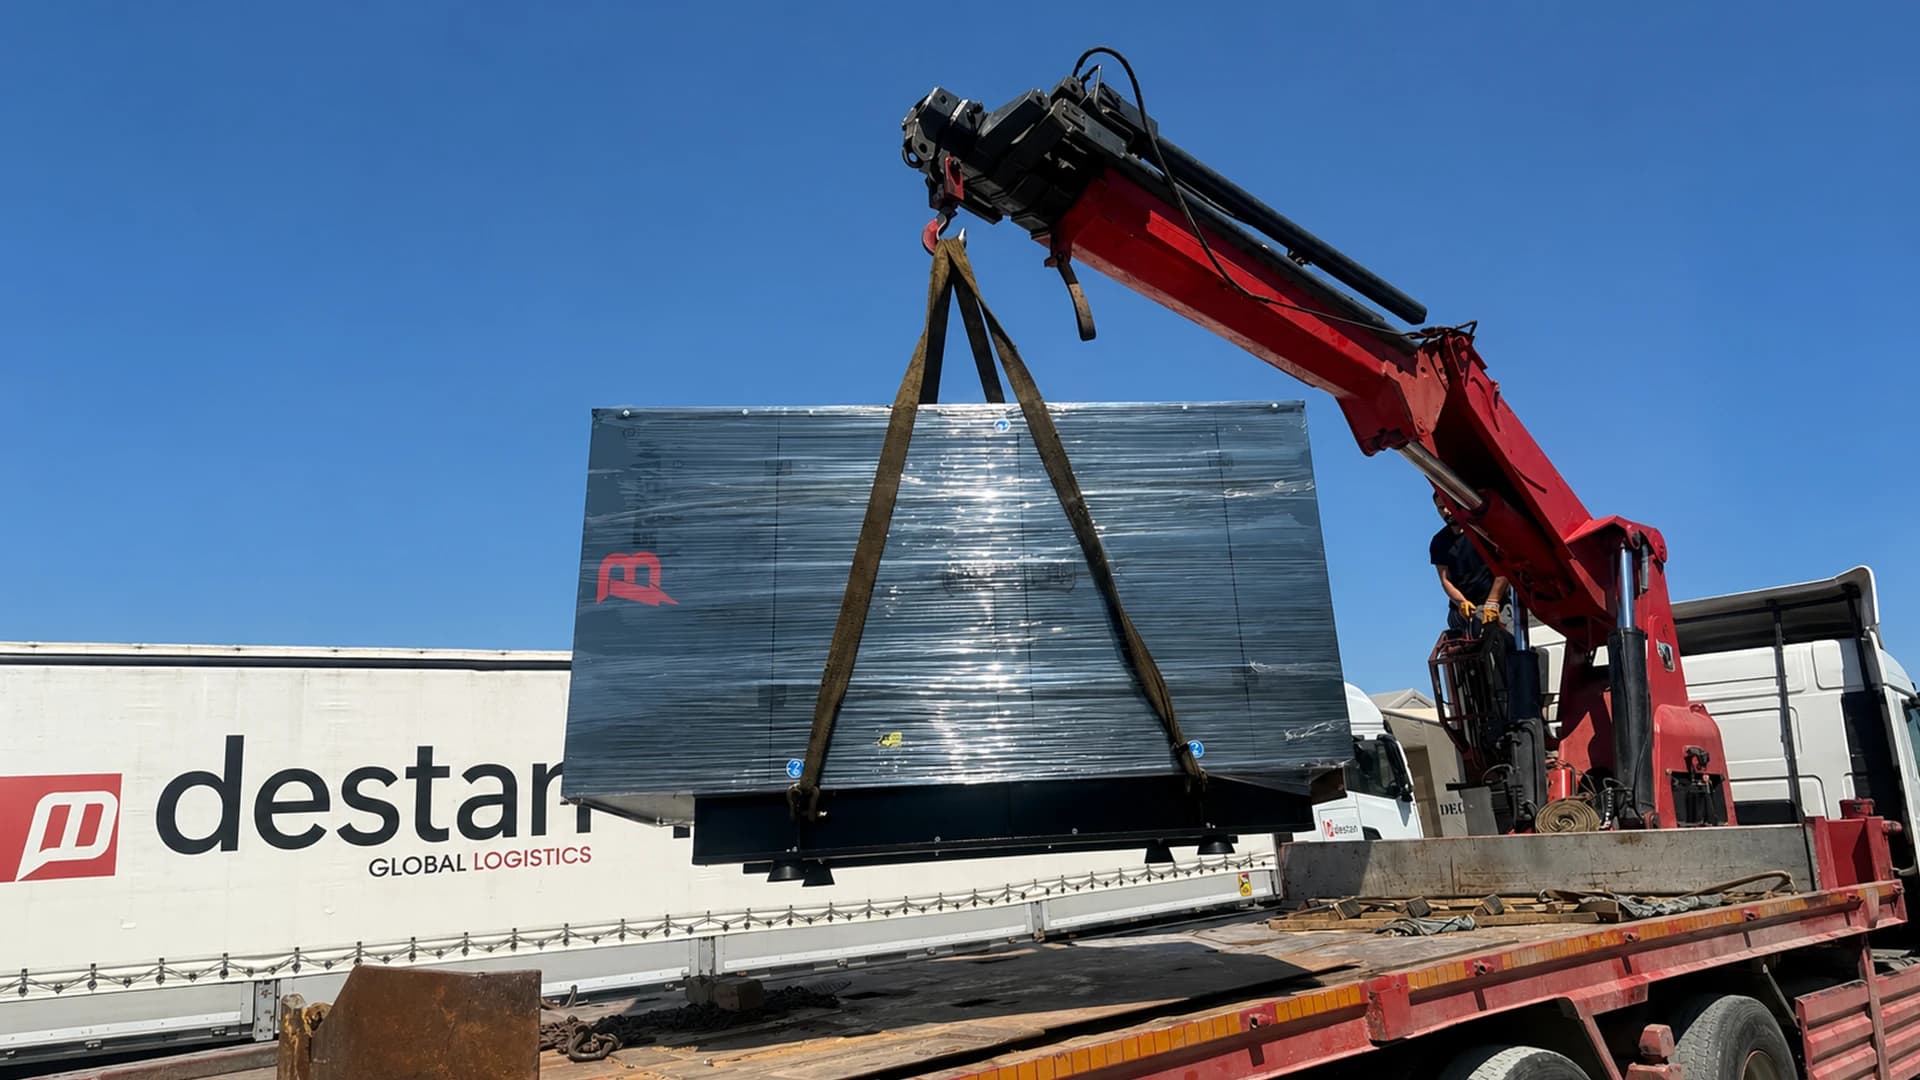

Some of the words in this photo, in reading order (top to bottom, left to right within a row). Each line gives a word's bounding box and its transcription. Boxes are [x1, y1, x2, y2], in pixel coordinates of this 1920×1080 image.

[1334, 824, 1358, 834] destan
[369, 854, 467, 878] GLOBAL
[474, 846, 591, 871] LOGISTICS
